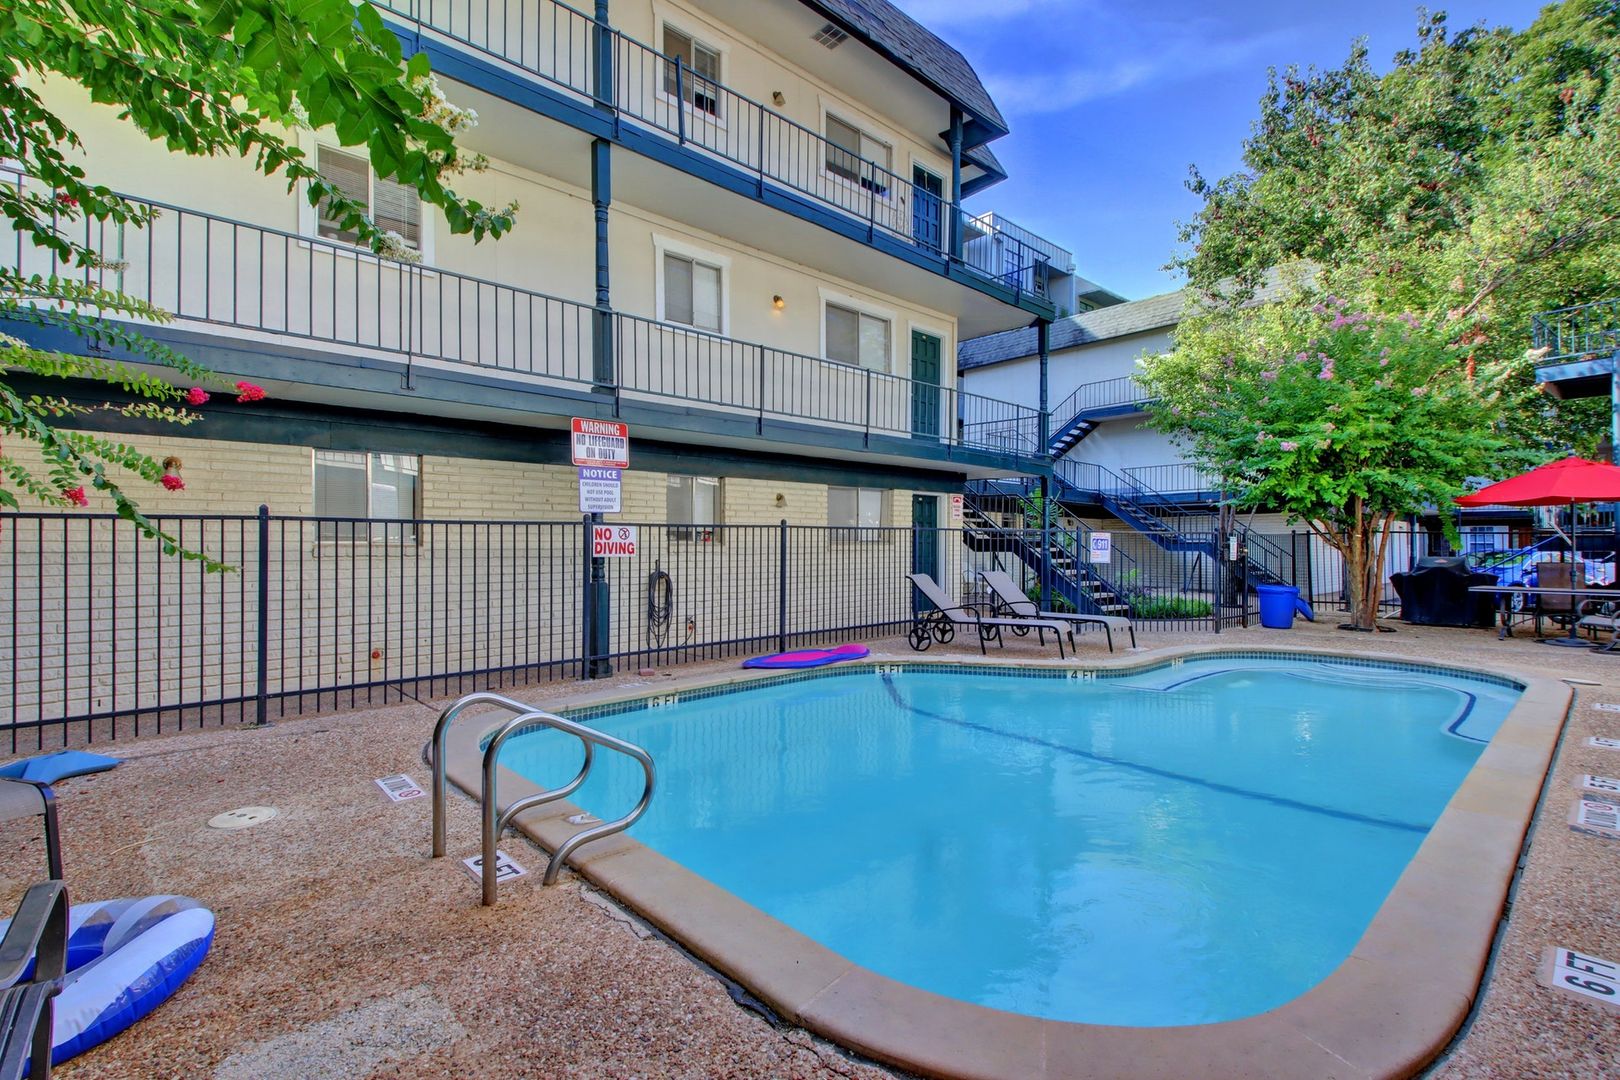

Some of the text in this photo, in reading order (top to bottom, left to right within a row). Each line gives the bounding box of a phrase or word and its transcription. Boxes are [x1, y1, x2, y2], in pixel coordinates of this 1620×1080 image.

[581, 420, 620, 436] WARNING
[576, 433, 625, 450] NO LIFEGUARD
[586, 446, 616, 460] ON DUTY
[582, 469, 618, 479] NOTICE
[594, 527, 612, 541] NO
[594, 541, 635, 555] DIVING
[1097, 539, 1108, 550] 911
[878, 664, 902, 674] 5 FT
[1070, 669, 1095, 680] 4 FT
[652, 693, 676, 708] 6 FT
[1564, 951, 1617, 996] 6 FT
